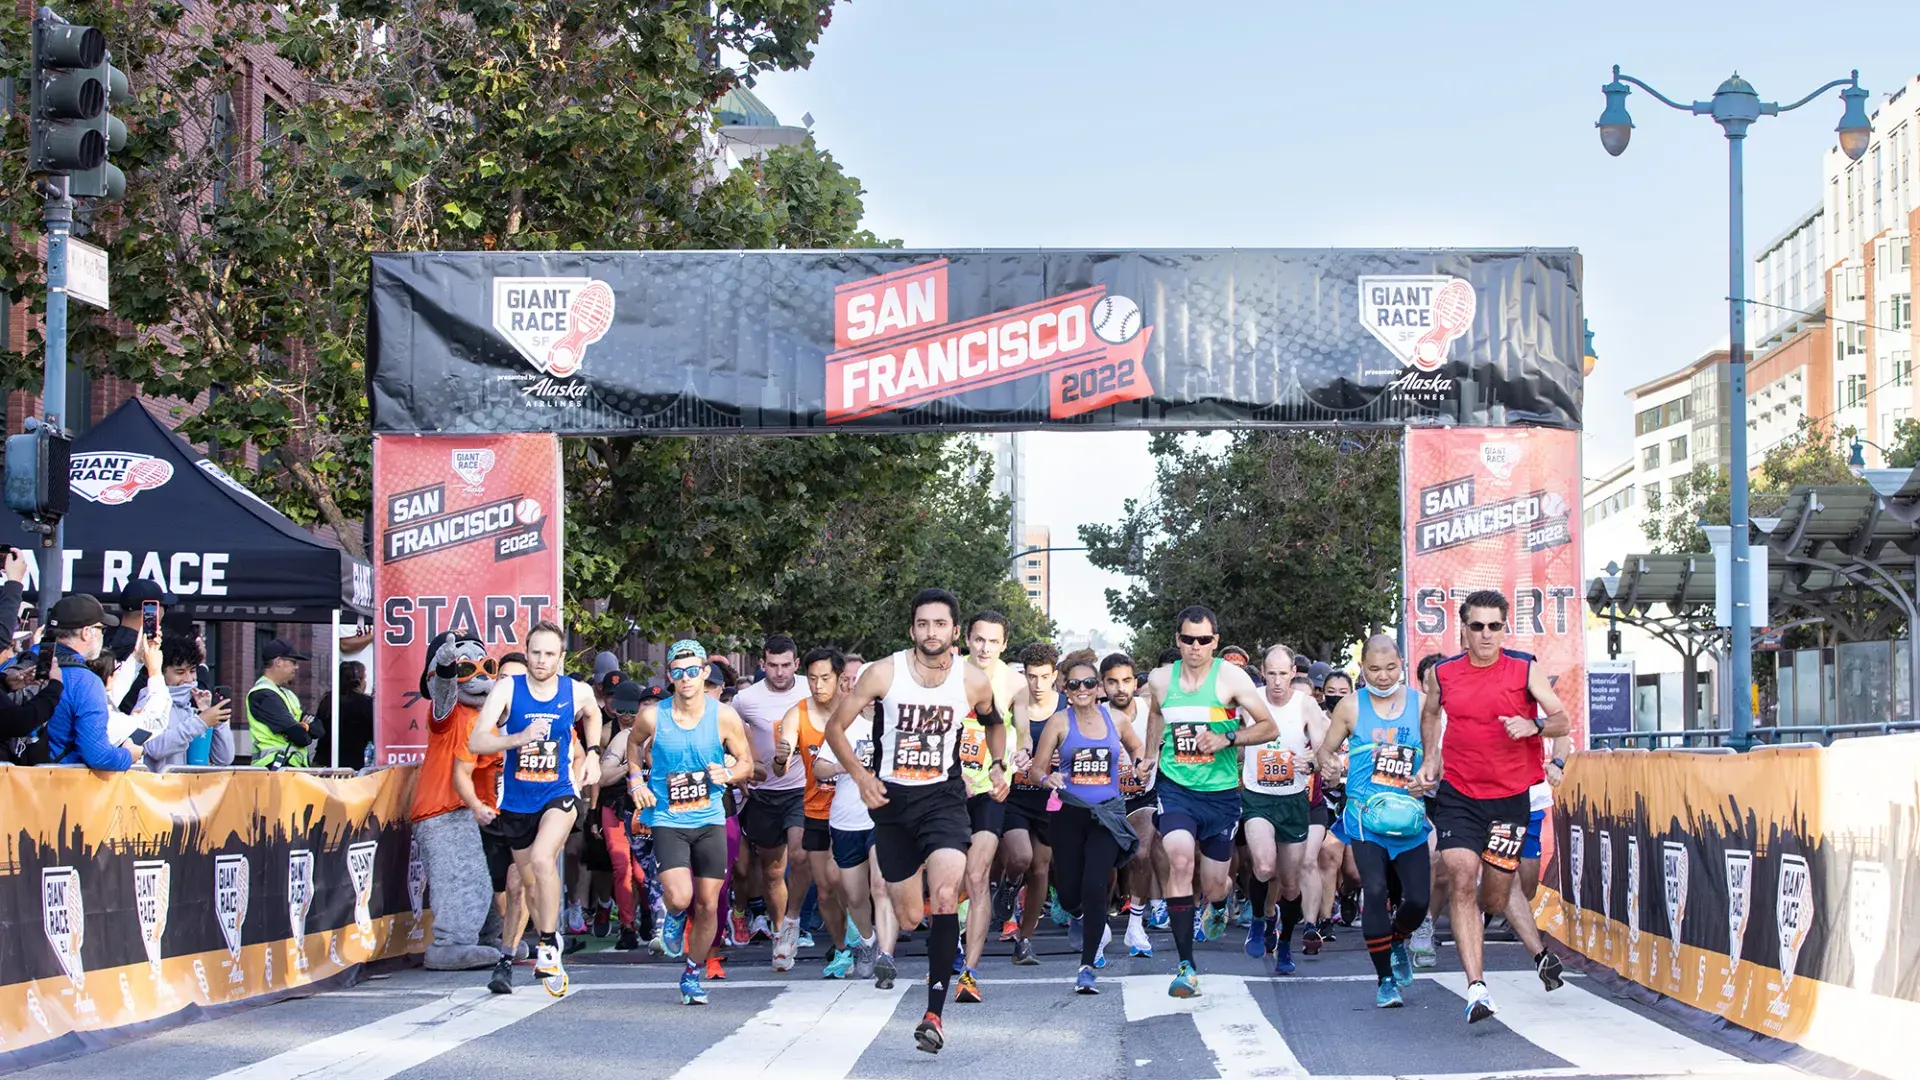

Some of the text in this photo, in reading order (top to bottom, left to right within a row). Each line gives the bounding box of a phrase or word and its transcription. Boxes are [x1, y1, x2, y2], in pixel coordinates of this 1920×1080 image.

[507, 289, 571, 309] GIANT
[1371, 287, 1433, 306] GIANT
[847, 277, 935, 341] SAN
[1377, 309, 1431, 327] RACE
[511, 312, 567, 331] RACE
[843, 304, 1086, 409] FRANCISCO
[497, 374, 537, 382] presented by
[521, 378, 588, 398] Alaska
[1061, 359, 1135, 404] 2022
[1388, 372, 1452, 392] Alaska
[525, 400, 582, 408] AIRLINES
[456, 453, 480, 461] GIANT
[1485, 447, 1506, 455] GIANT
[1486, 455, 1506, 463] RACE
[70, 458, 132, 469] GIANT
[458, 461, 479, 469] RACE
[70, 469, 125, 481] RACE
[394, 490, 440, 523] SAN
[1425, 483, 1469, 516] SAN
[391, 503, 514, 557] FRANCISCO
[1423, 498, 1539, 549] FRANCISCO
[500, 530, 539, 555] 2022
[1527, 525, 1564, 547] 2022
[102, 550, 230, 596] RACE
[895, 703, 954, 734] HMB
[520, 755, 556, 768] 2870
[897, 750, 940, 766] 3206
[1073, 761, 1108, 772] 2999
[1377, 757, 1413, 777] 2002
[1264, 764, 1287, 775] 386
[670, 783, 707, 800] 2236
[1487, 835, 1521, 855] 2717
[219, 867, 237, 890] GIANT
[1782, 870, 1805, 898] GIANT
[47, 881, 67, 907] GIANT
[220, 892, 237, 914] RACE
[49, 909, 70, 935] RACE
[1782, 900, 1799, 928] RACE
